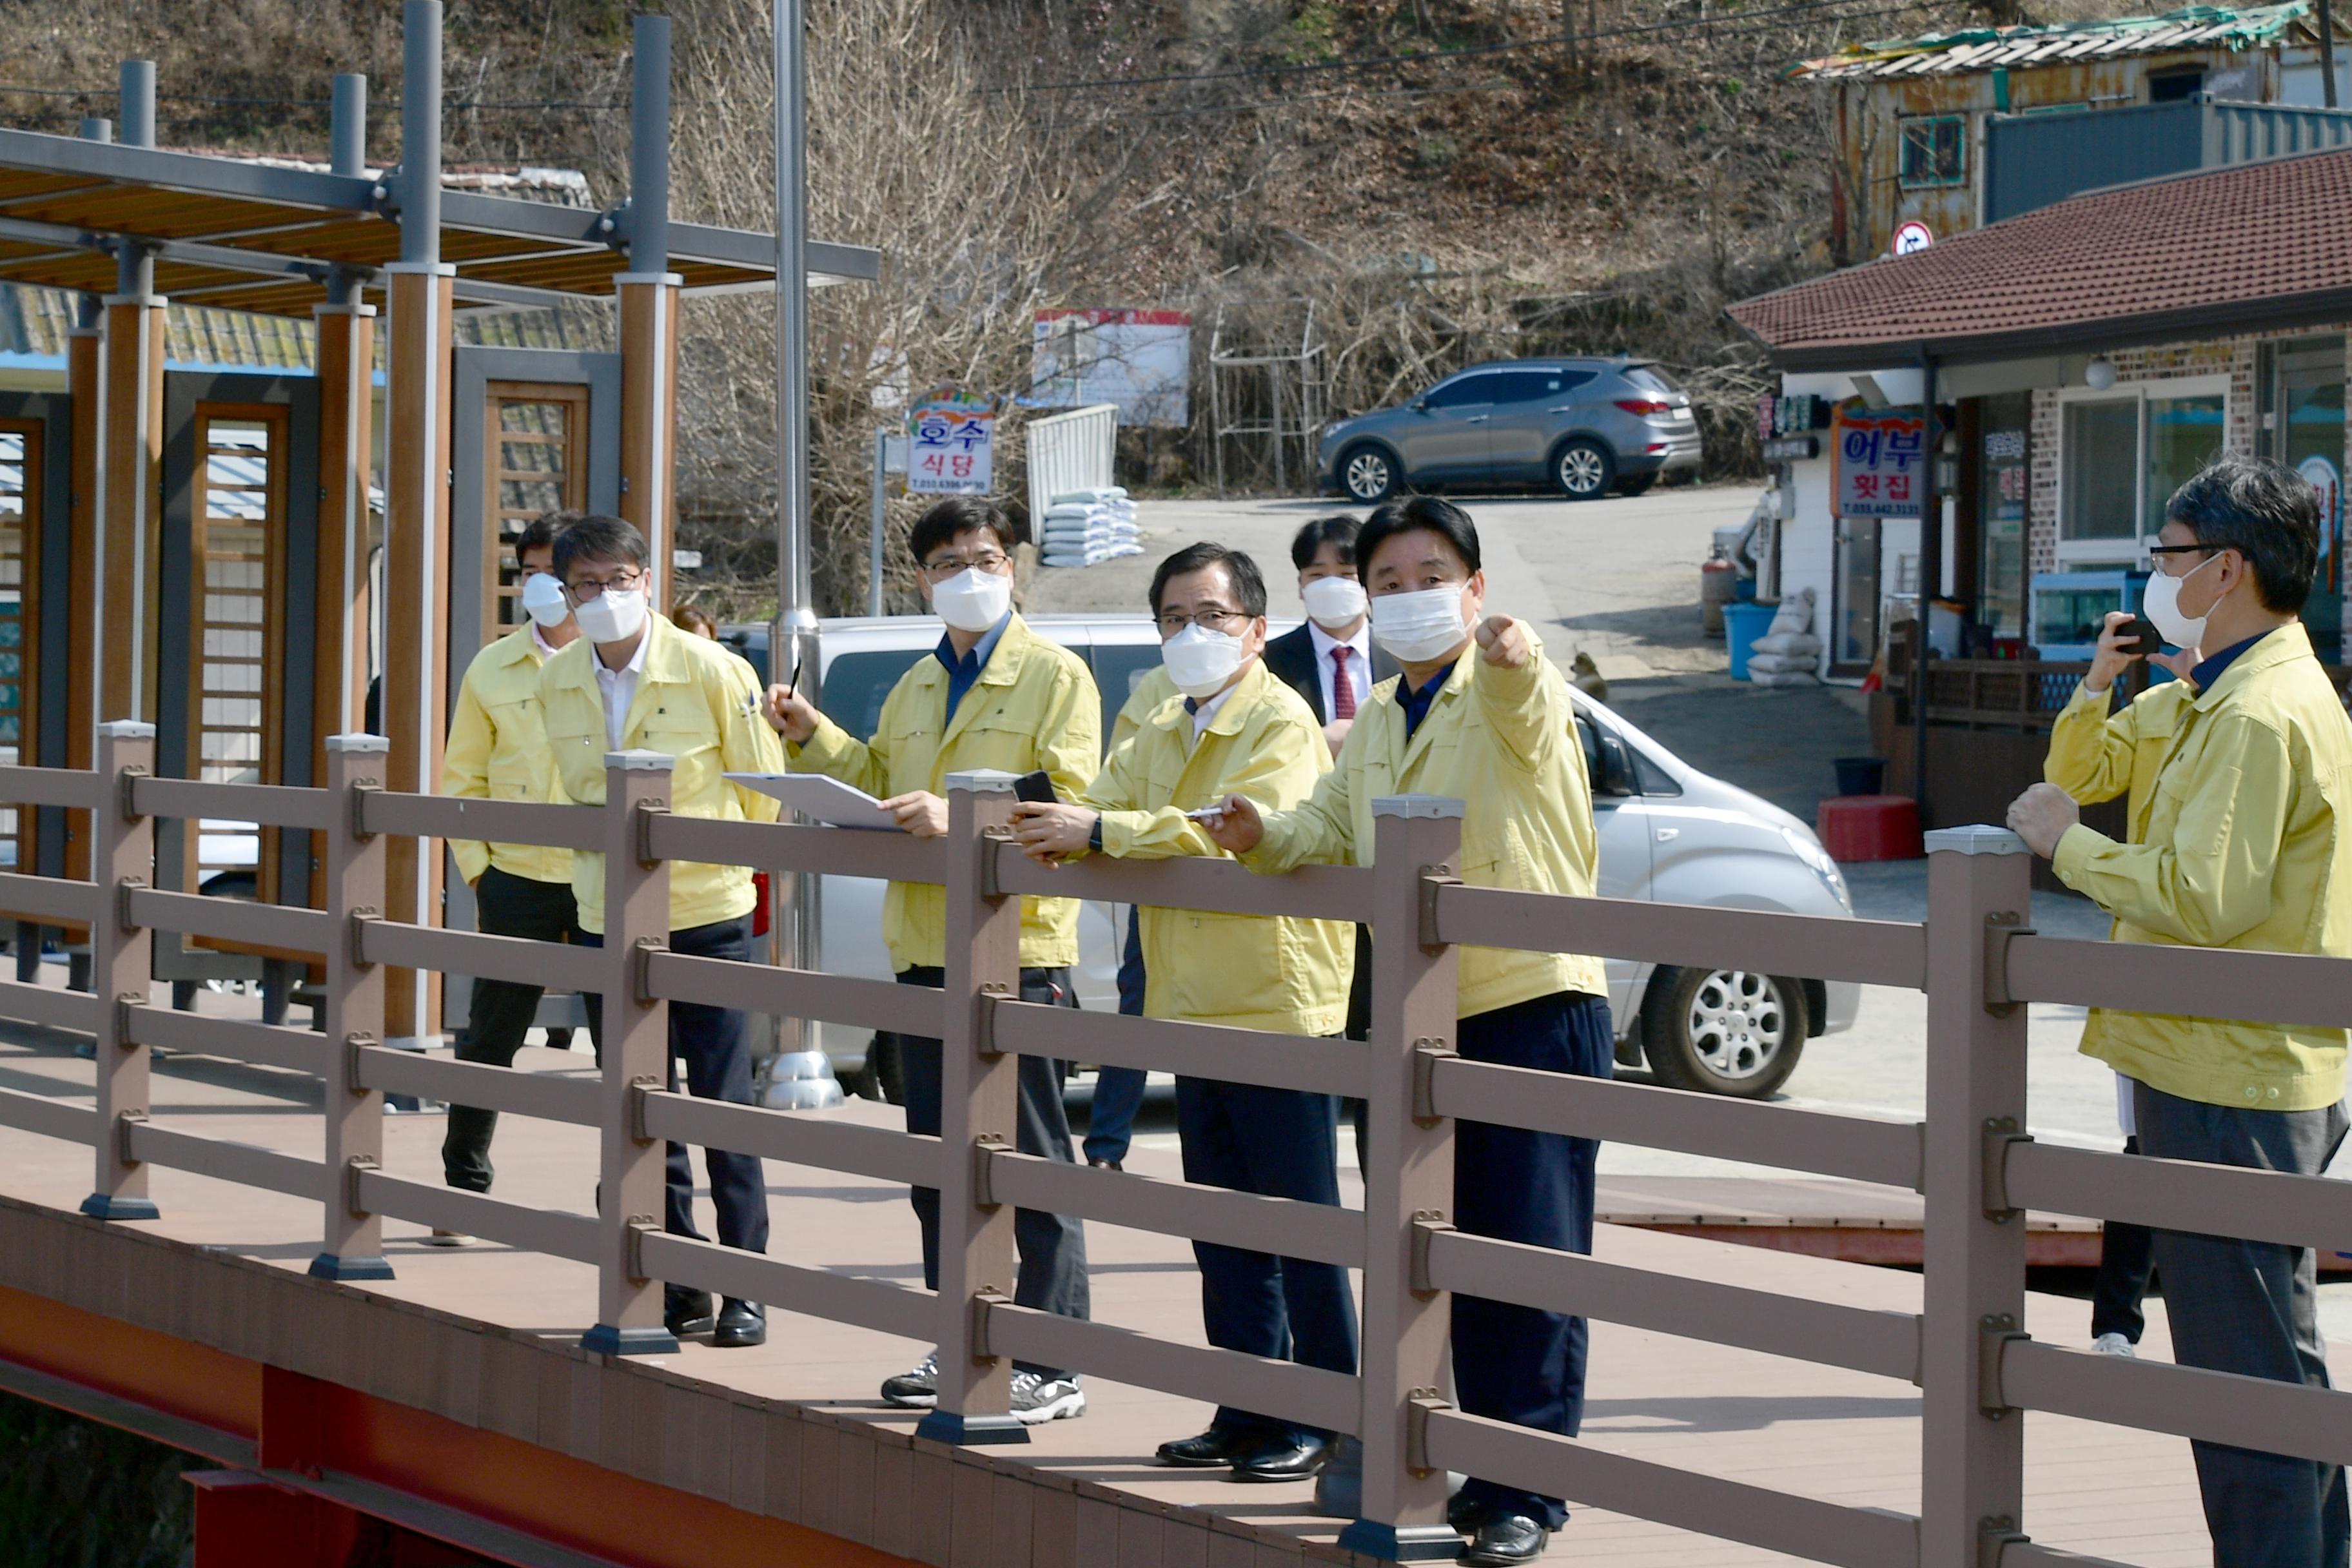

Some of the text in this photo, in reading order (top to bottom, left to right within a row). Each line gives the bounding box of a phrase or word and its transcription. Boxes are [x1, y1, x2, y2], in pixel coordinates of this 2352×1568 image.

[916, 418, 988, 452] 호수
[921, 454, 974, 477] 식당
[1845, 430, 1922, 472] 어부
[1852, 474, 1910, 500] 횟집
